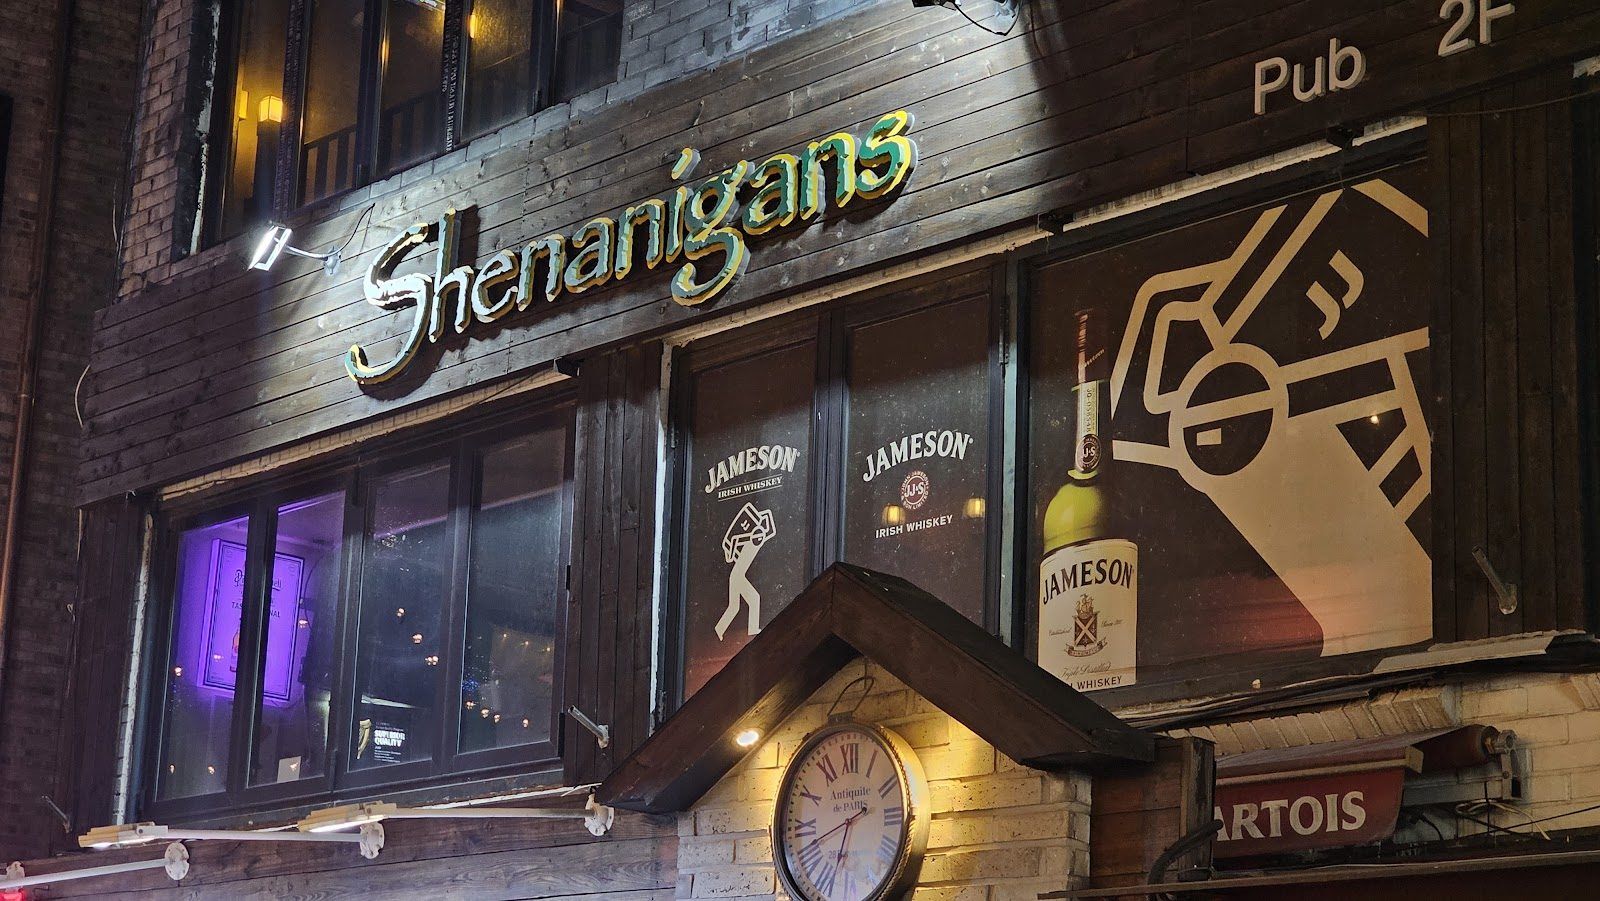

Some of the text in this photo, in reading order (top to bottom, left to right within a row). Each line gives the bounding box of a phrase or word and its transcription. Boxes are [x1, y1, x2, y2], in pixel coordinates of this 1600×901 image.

[1254, 0, 1515, 115] Pub 2F
[345, 110, 917, 385] Shenanigans
[704, 445, 798, 494] JAMESON
[862, 430, 971, 483] JAMESON
[718, 476, 783, 499] IRISH WHISKEY
[875, 514, 953, 539] IRISH WHISKEY
[1042, 558, 1133, 606] JAMESON
[1077, 675, 1122, 690] WHISKEY
[816, 753, 838, 787] XI
[839, 742, 859, 775] XII
[799, 784, 822, 806] X
[842, 800, 868, 813] PARIS
[795, 817, 816, 838] IX
[883, 806, 903, 826] III
